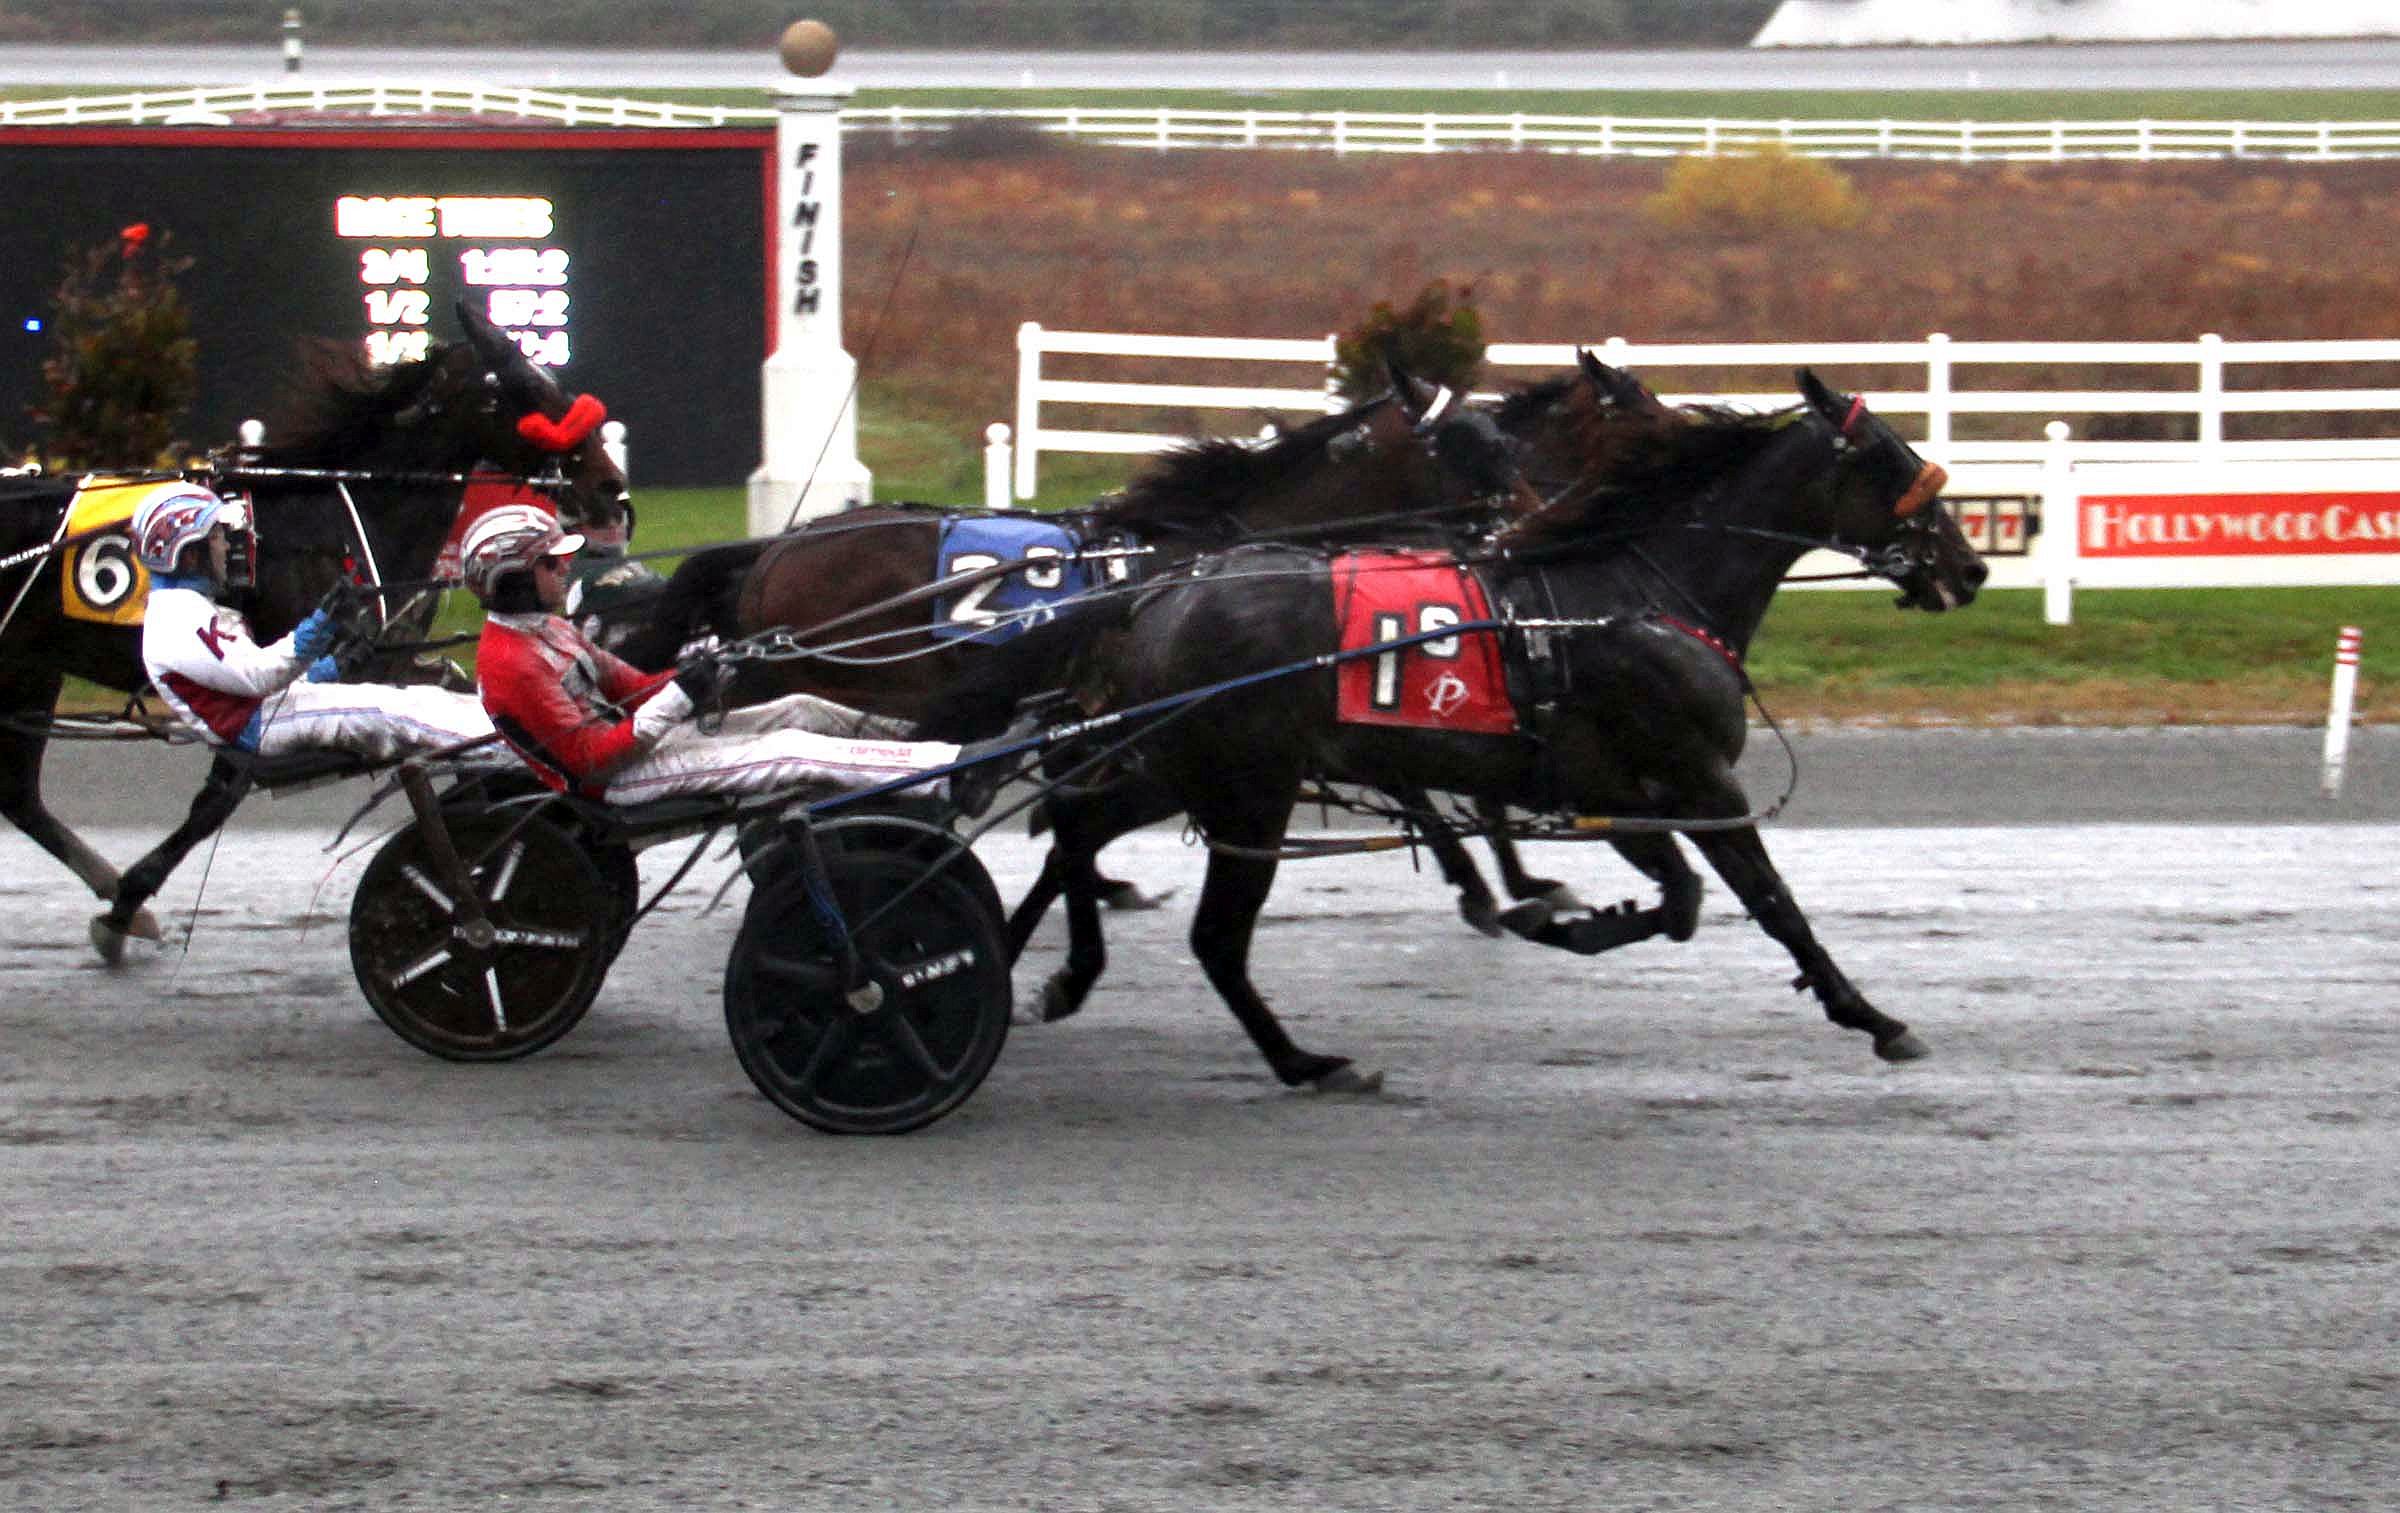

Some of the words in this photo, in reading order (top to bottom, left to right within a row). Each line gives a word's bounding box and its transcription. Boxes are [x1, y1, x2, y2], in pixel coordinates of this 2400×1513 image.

[794, 143, 821, 315] FINISH
[78, 534, 132, 605] 6
[951, 553, 1000, 626] 2
[196, 616, 237, 661] K
[1375, 617, 1399, 705] 1
